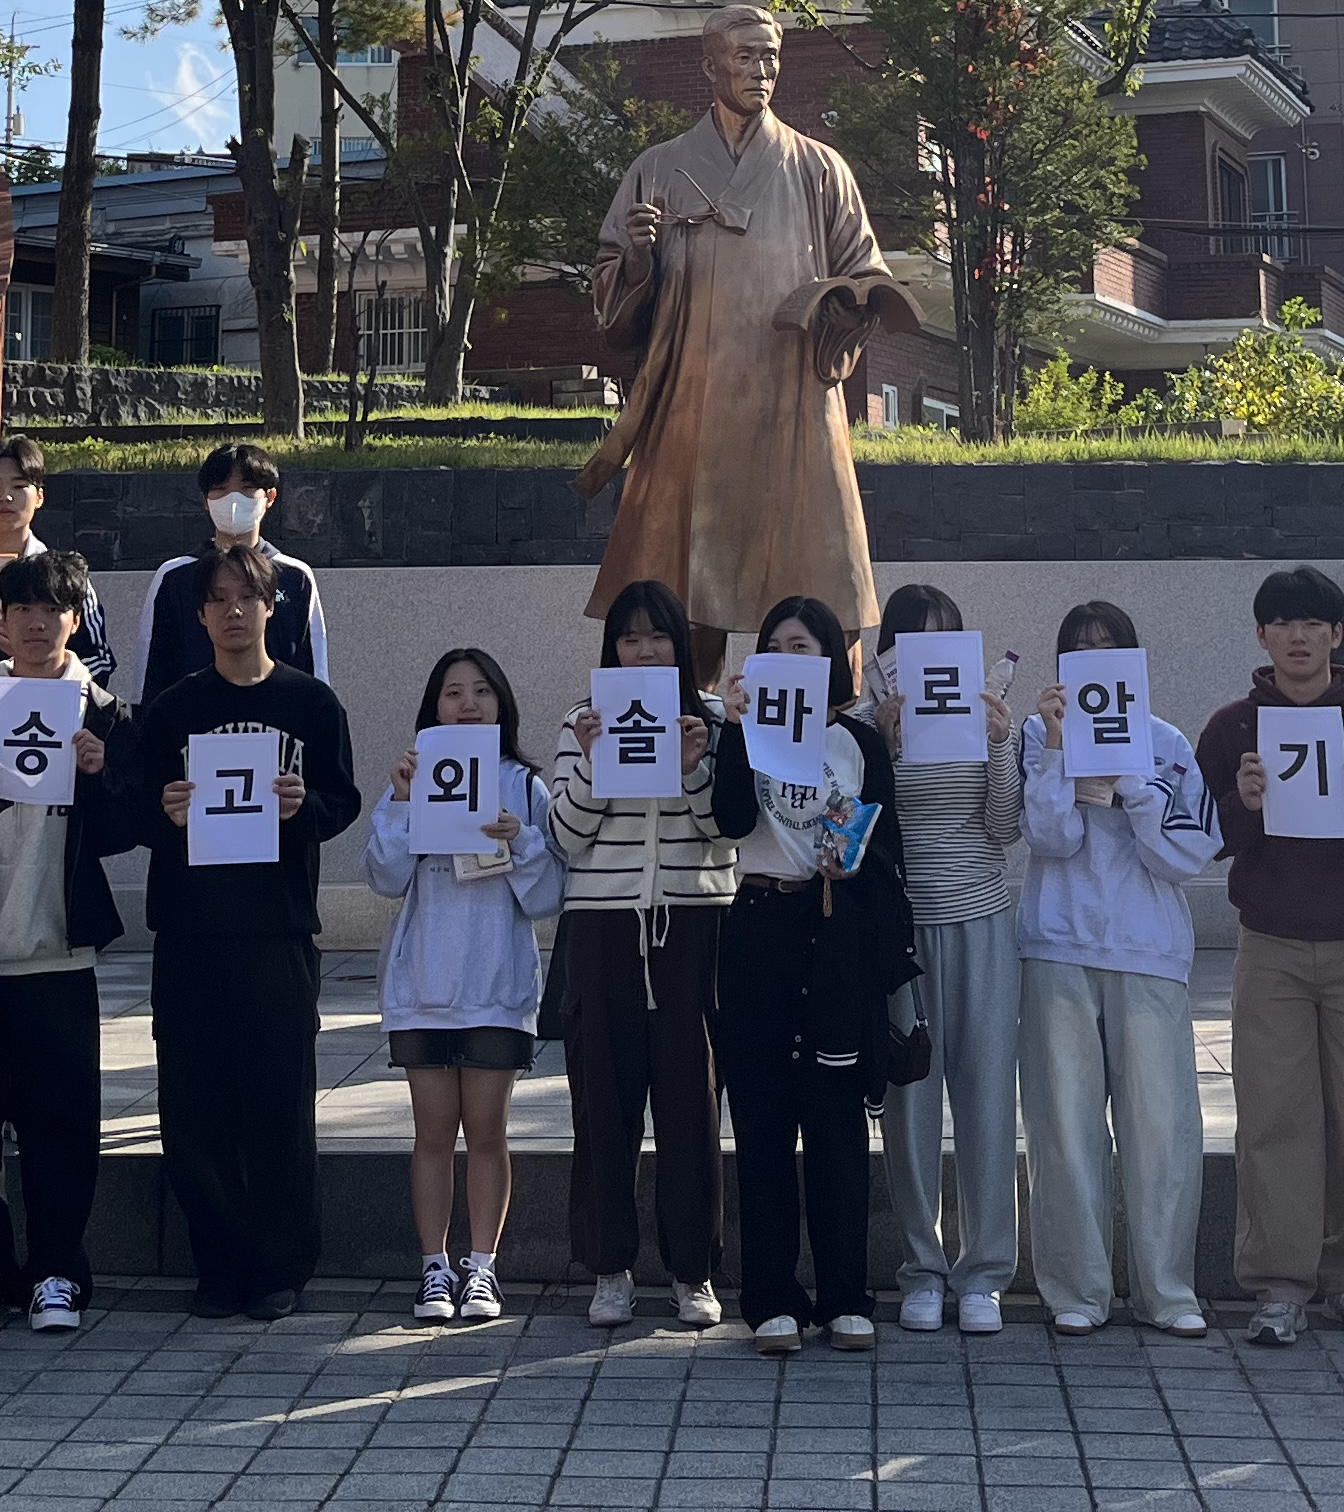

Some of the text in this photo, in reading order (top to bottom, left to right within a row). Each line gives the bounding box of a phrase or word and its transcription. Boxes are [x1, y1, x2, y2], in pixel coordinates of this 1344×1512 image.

[757, 687, 812, 742] 바
[915, 667, 970, 715] 로
[1078, 682, 1134, 744] 알
[4, 712, 62, 775] 송
[609, 700, 666, 764] 솔
[206, 769, 262, 815] 고
[428, 758, 478, 812] 외
[1278, 741, 1328, 795] 기
